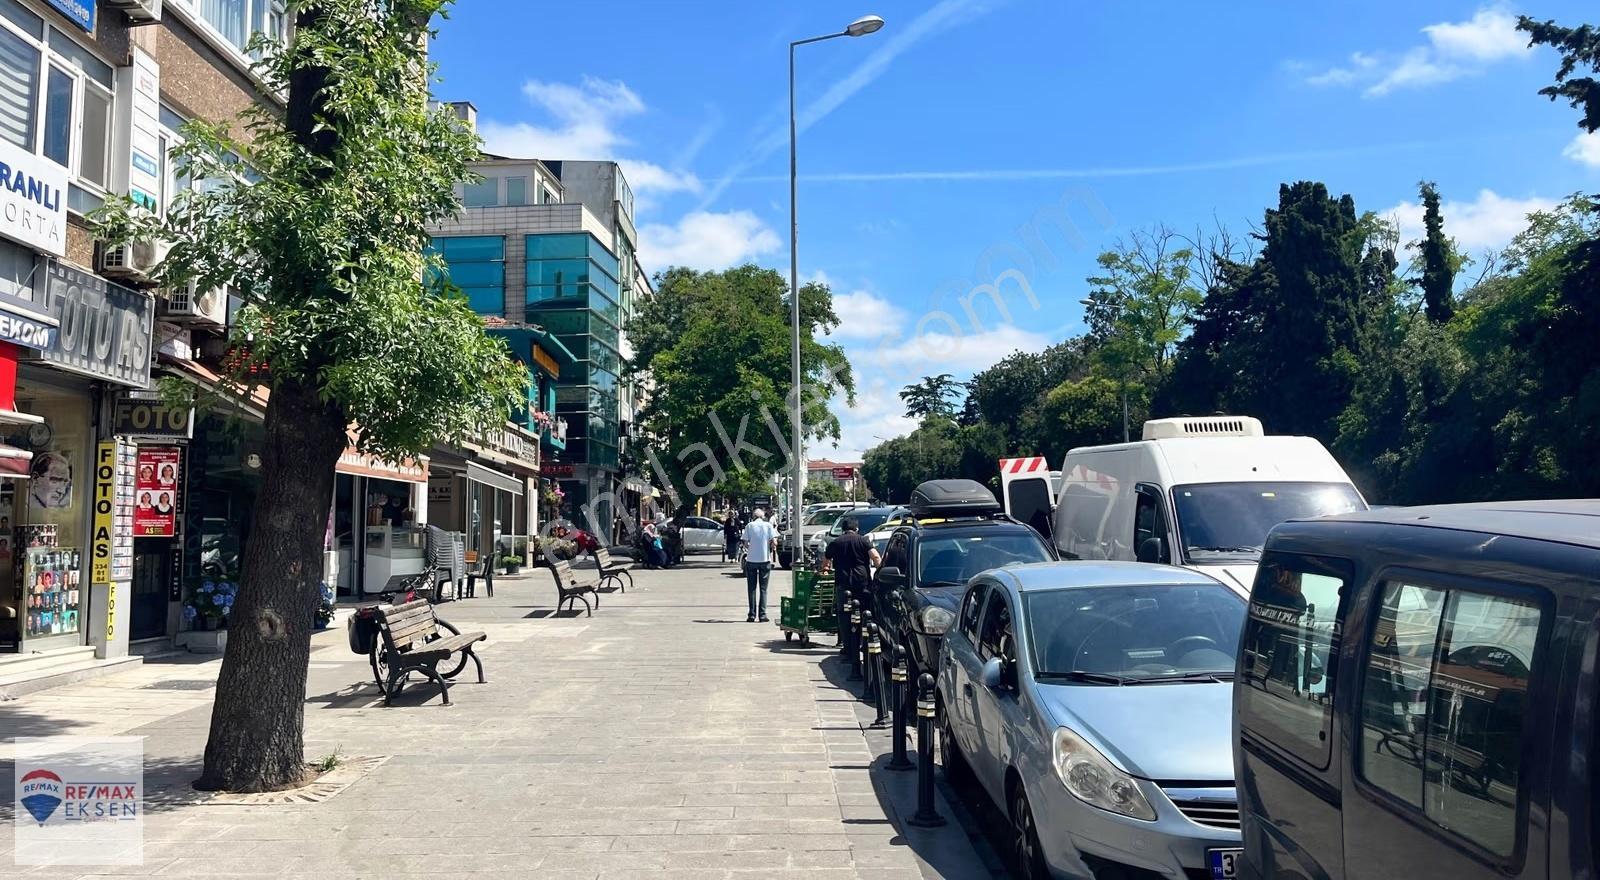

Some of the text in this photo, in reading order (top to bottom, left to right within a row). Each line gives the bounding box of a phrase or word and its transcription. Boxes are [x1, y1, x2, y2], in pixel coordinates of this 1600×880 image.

[47, 277, 148, 370] FOTO AS
[116, 404, 188, 430] FOTO
[95, 448, 113, 559] FOTO AS
[107, 586, 115, 636] FOTO
[1223, 854, 1240, 875] 3
